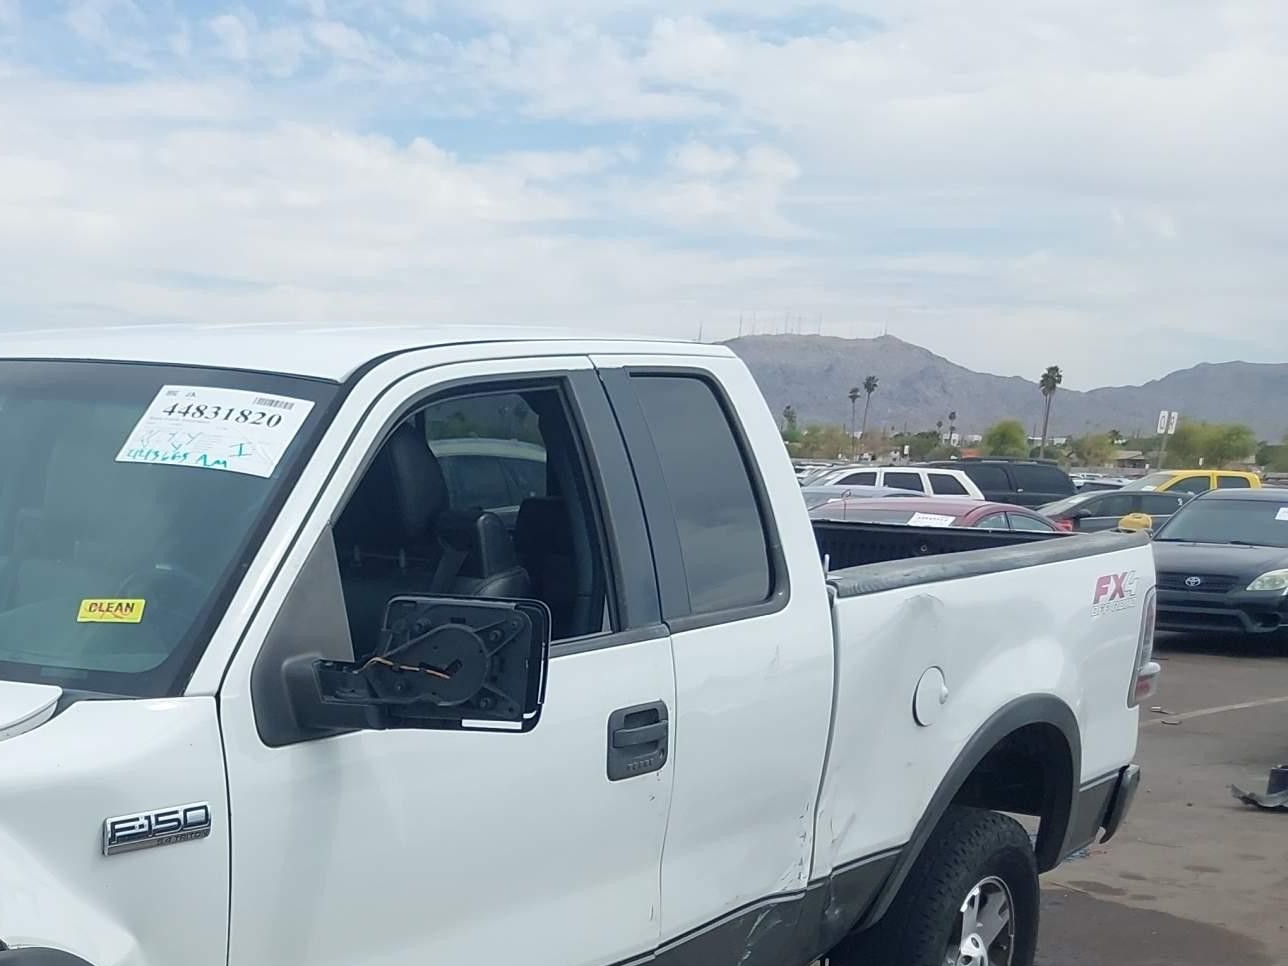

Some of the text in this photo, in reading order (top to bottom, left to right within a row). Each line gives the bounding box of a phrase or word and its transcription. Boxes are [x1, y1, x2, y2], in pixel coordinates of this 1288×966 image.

[162, 402, 283, 428] 44831820
[1092, 570, 1138, 605] FX4
[88, 602, 135, 613] CLEAN
